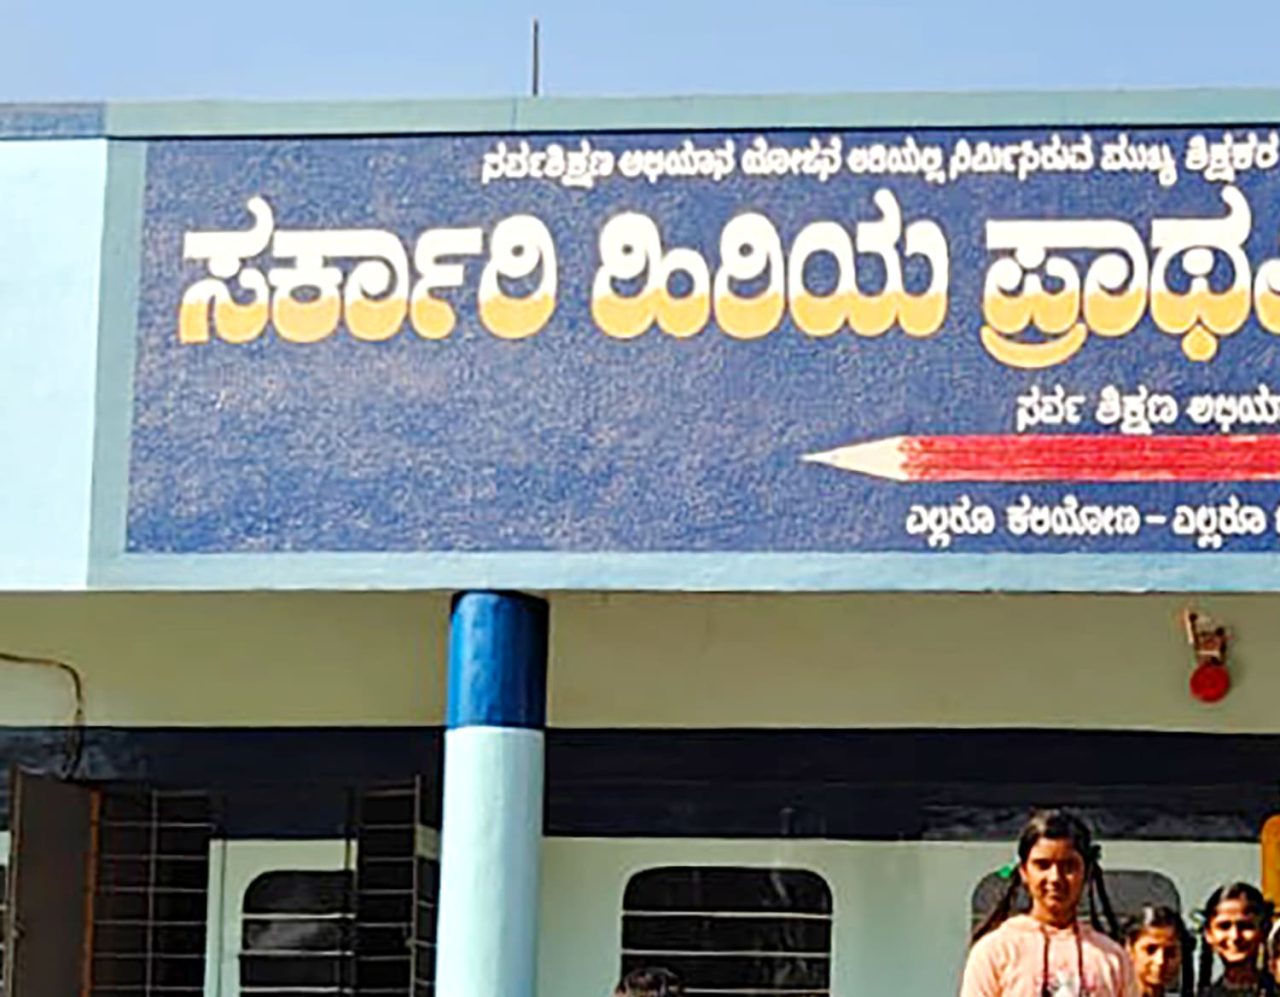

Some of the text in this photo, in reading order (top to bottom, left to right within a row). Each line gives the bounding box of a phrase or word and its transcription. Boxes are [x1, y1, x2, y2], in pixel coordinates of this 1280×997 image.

[617, 139, 736, 184] ಅಭಿಯಾನ
[1185, 131, 1280, 183] ಶಿಕ್ಷಕರ
[178, 195, 558, 345] ಸರ್ಕಾರಿ
[591, 188, 949, 339] ಹಿರಿಯ
[1016, 384, 1087, 432] ಸರ್ವ
[1095, 384, 1179, 435] ಶಿಕ್ಷಣ
[906, 494, 996, 548] ಎಲ್ಲರೂ
[1006, 494, 1141, 535] ಕಲಿಯೋಣ
[1172, 495, 1267, 548] ಎಲ್ಲರೂ
